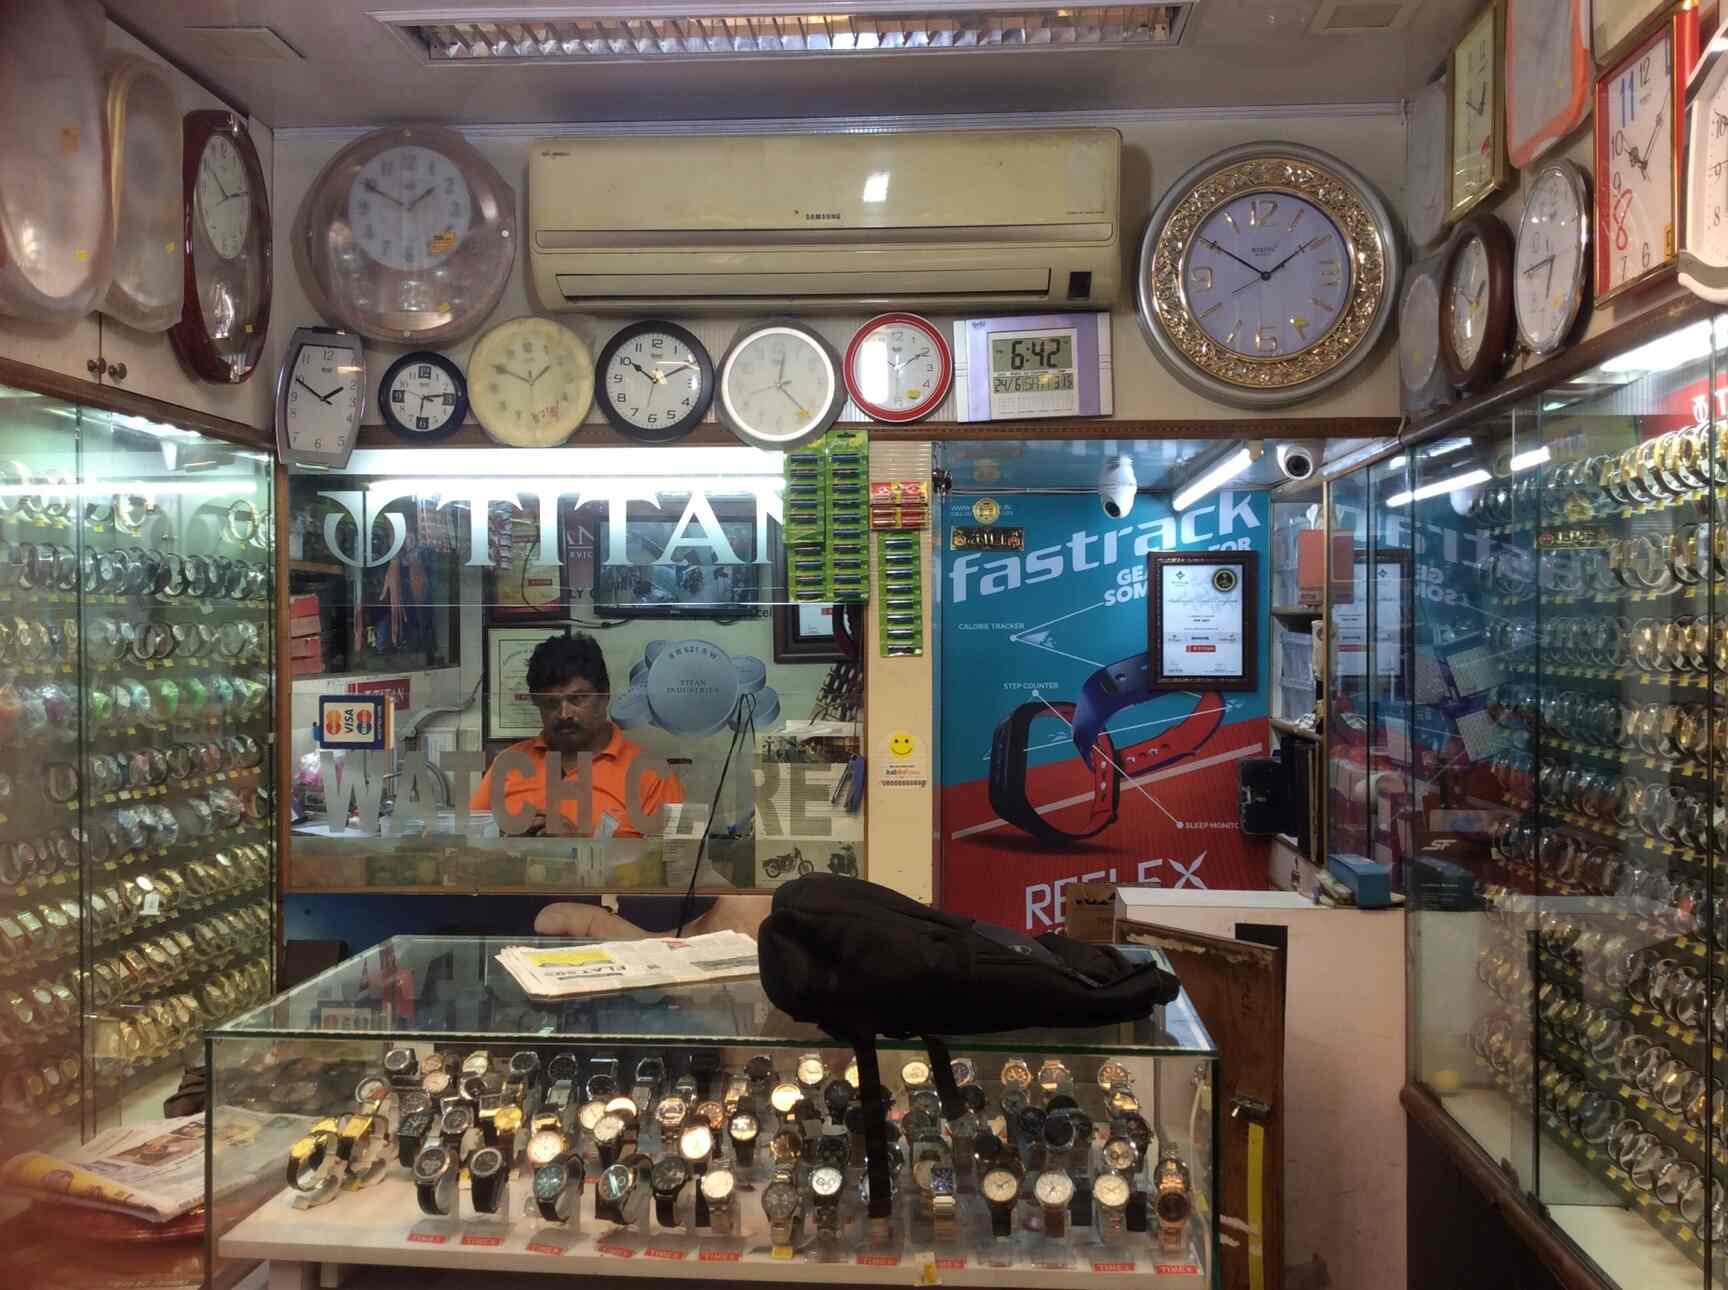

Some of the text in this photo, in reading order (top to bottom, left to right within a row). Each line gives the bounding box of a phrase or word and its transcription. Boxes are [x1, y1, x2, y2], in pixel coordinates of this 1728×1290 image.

[1640, 57, 1650, 87] 12
[1620, 71, 1635, 128] 11
[1611, 130, 1624, 160] 10
[1250, 200, 1279, 227] 12
[1612, 189, 1633, 250] 8
[1010, 337, 1062, 371] 6:42
[949, 490, 1261, 603] fastrack
[1117, 565, 1148, 585] GE
[1104, 581, 1148, 606] SOM
[958, 622, 1025, 631] CALORIE TRACKER
[680, 679, 707, 687] TITAN
[1023, 682, 1059, 690] COUNTER
[344, 708, 354, 734] VISA
[319, 750, 833, 837] WATCH CARE
[1025, 850, 1208, 930] REEX
